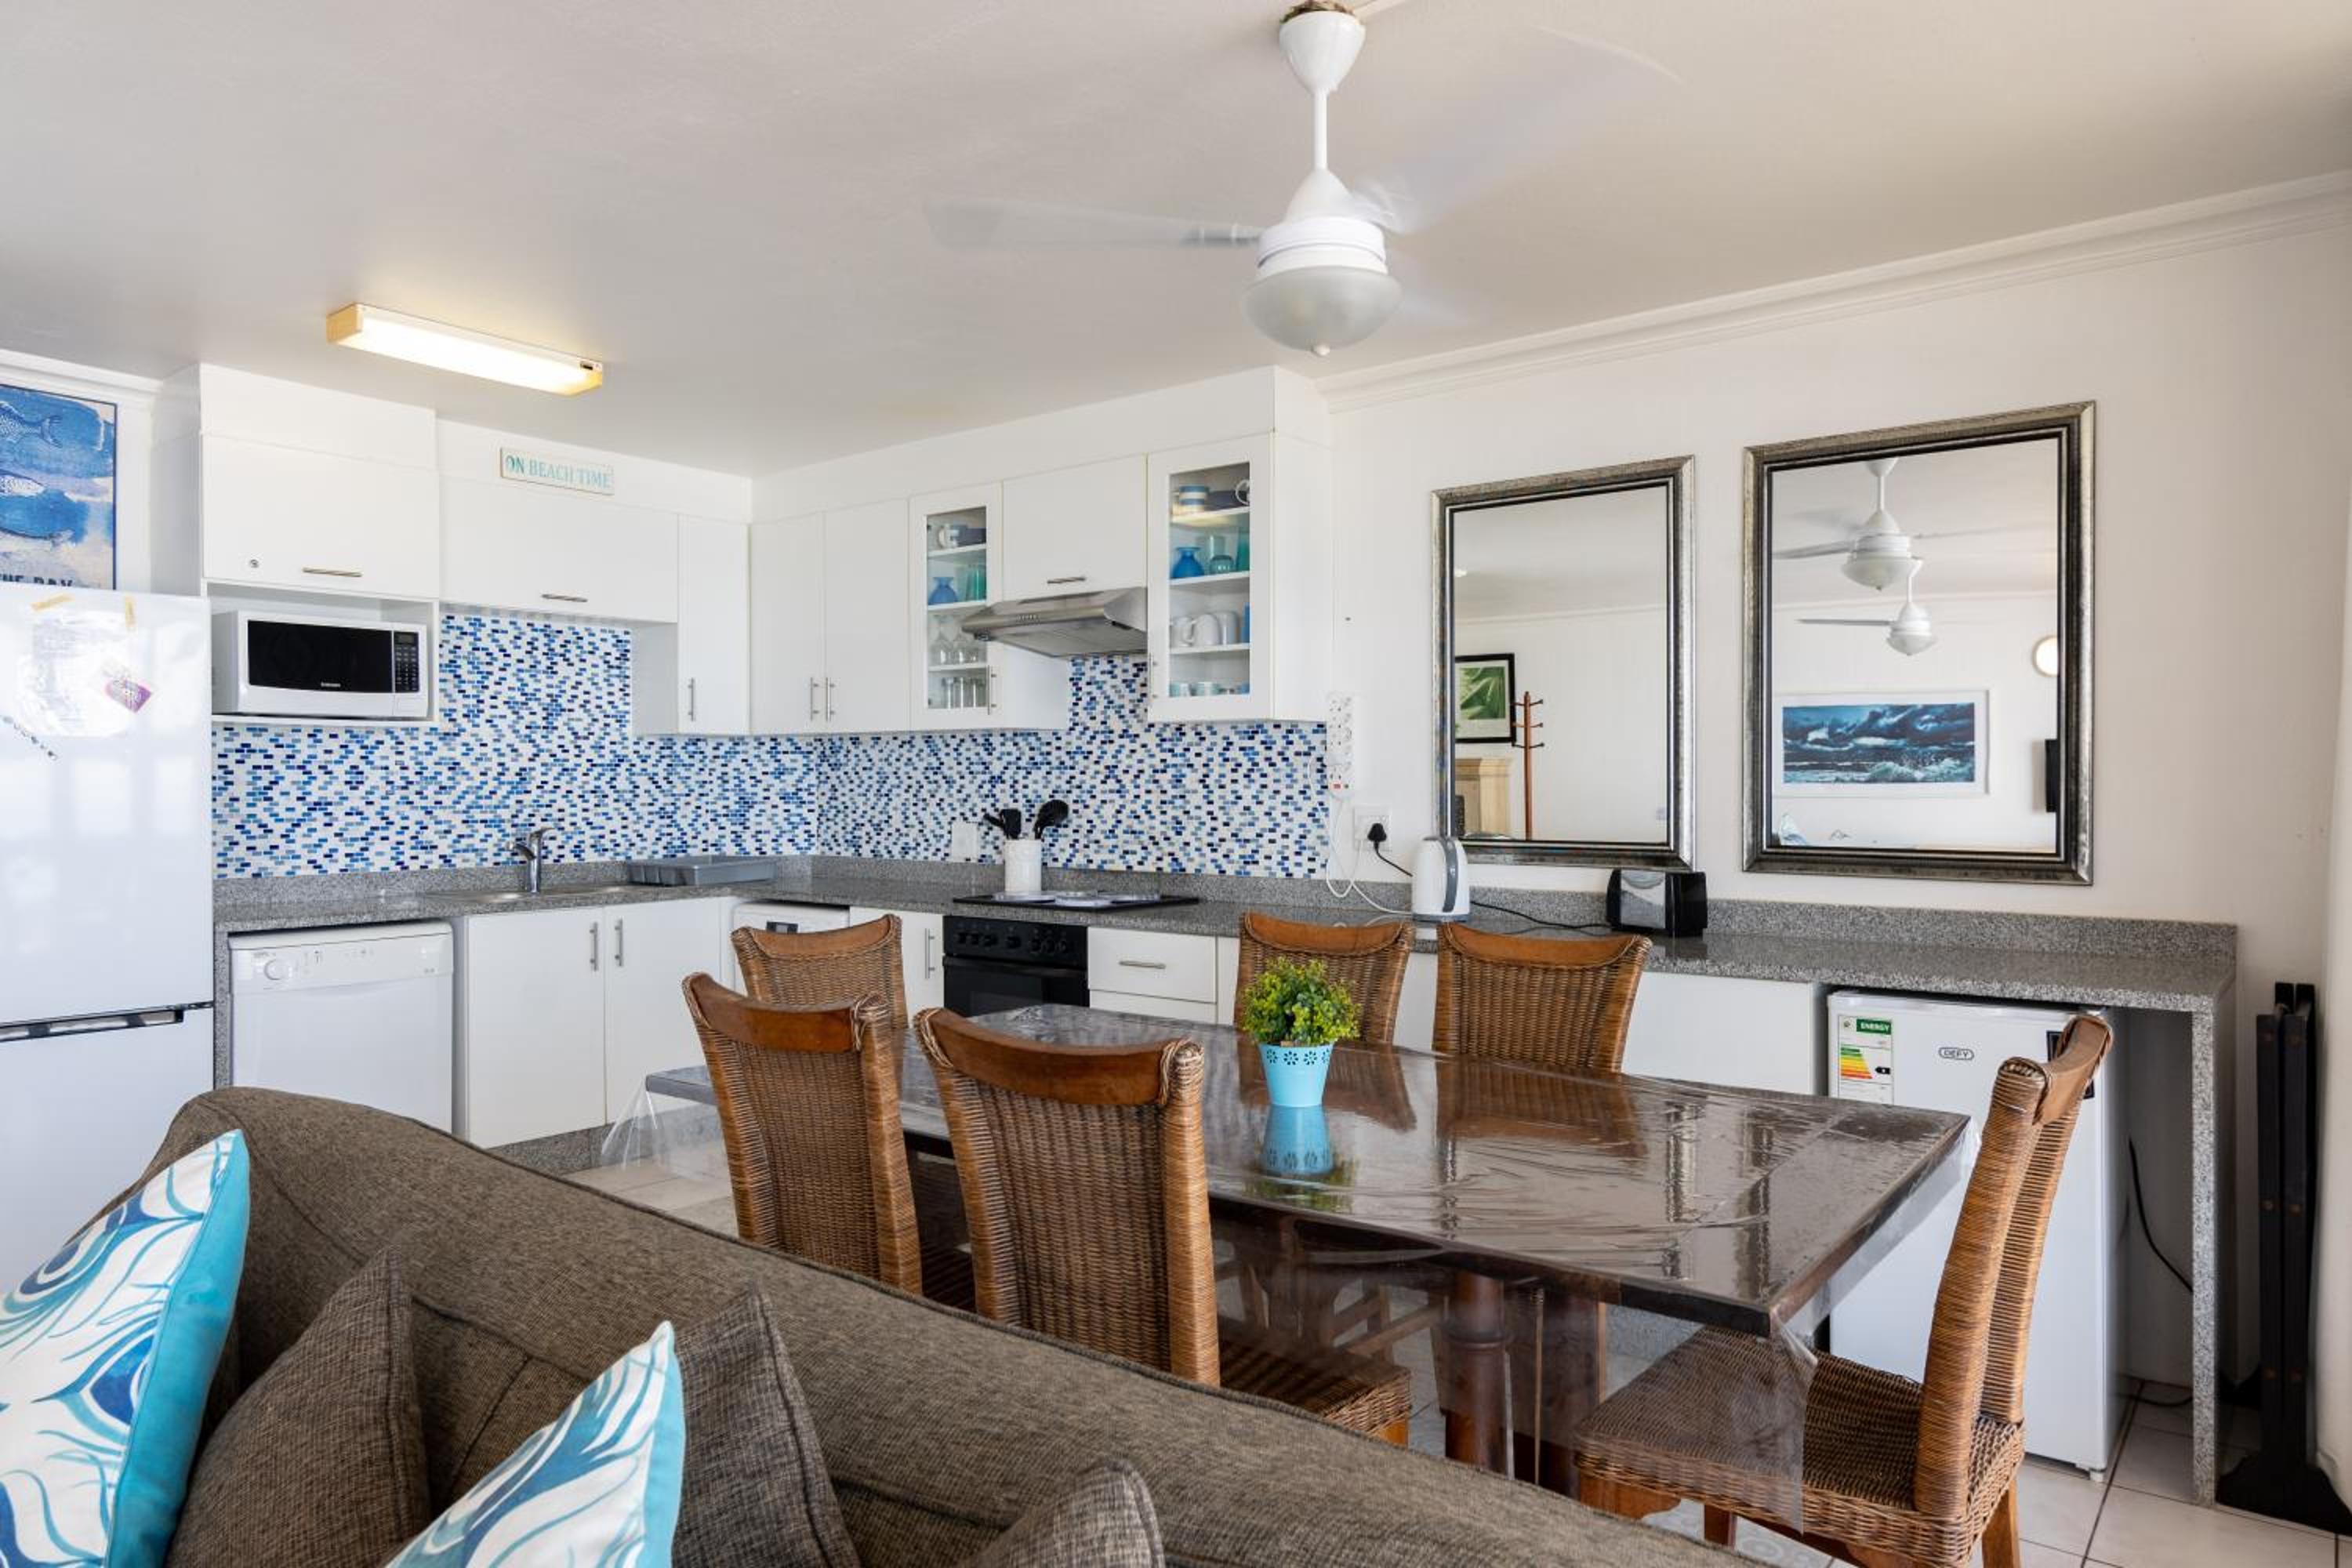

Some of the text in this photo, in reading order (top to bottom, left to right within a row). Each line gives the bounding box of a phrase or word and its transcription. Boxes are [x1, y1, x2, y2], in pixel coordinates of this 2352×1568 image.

[505, 455, 612, 488] ON BEACH TIME
[1860, 1022, 1890, 1033] ENERGY
[1944, 1050, 1969, 1058] DEFY
